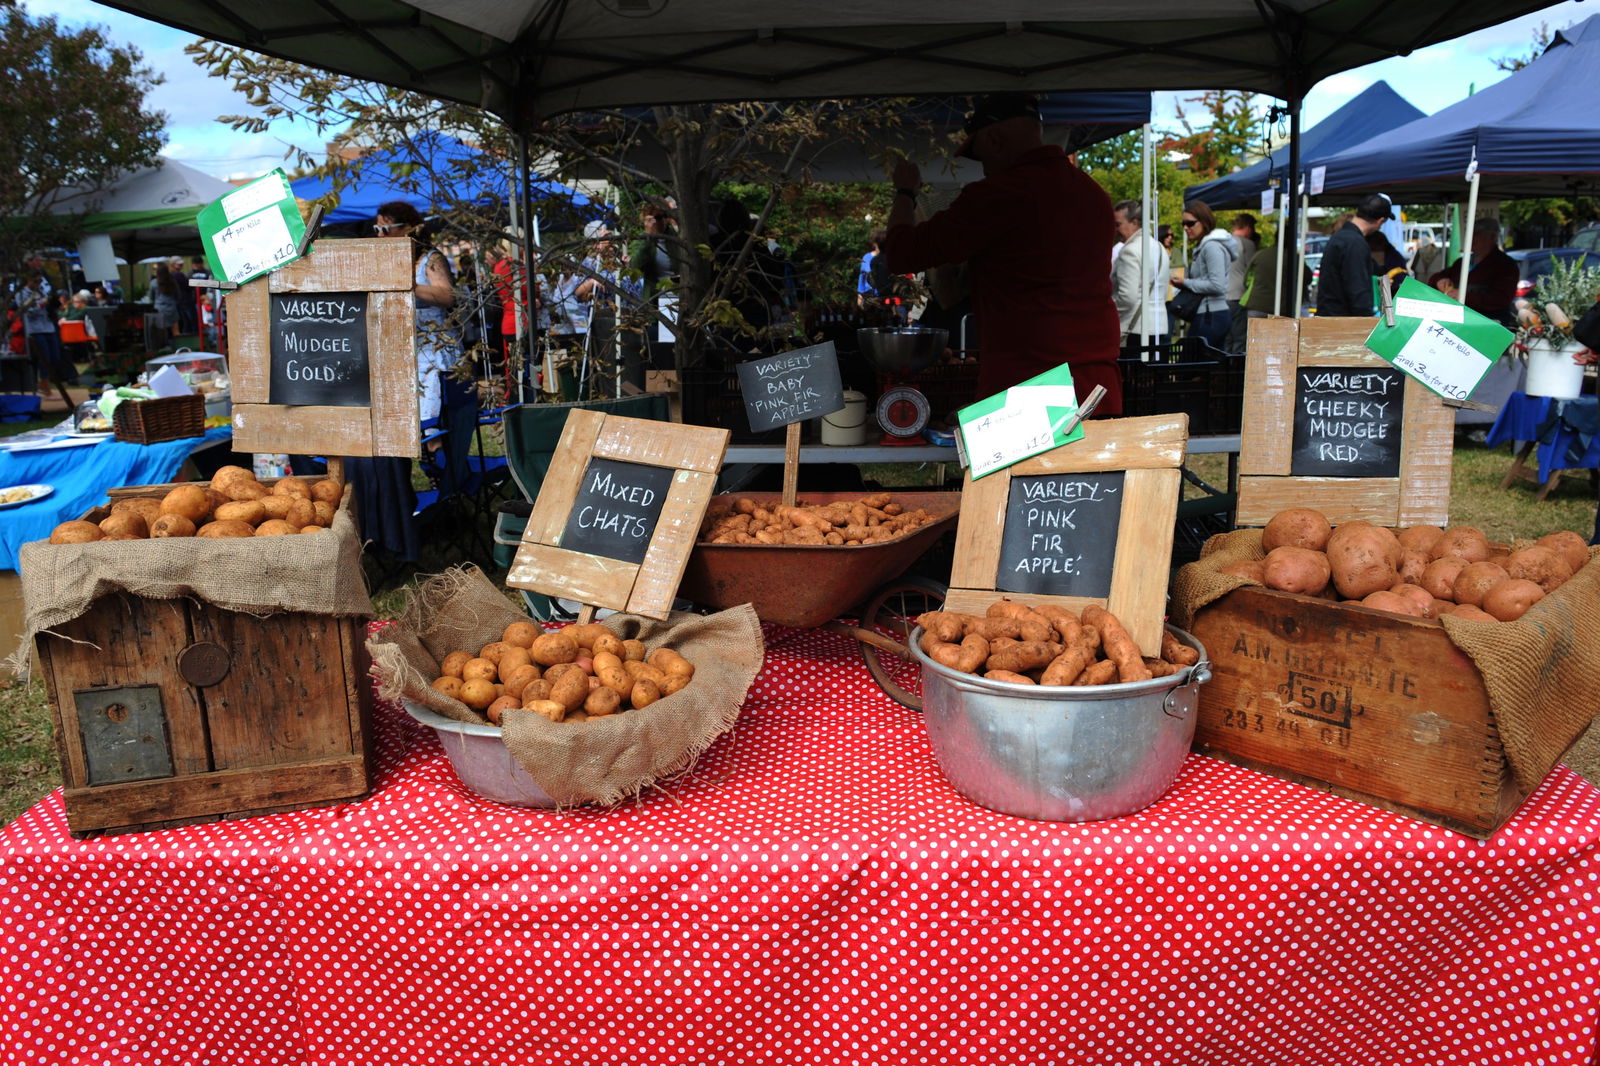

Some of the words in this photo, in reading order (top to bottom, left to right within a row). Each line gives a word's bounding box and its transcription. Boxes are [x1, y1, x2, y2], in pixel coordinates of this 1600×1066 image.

[273, 243, 294, 262] $10
[279, 299, 345, 319] VARIETY
[1426, 325, 1444, 338] $4
[1443, 336, 1456, 347] per
[1456, 343, 1471, 357] kilo
[756, 353, 810, 377] VARIETY
[767, 374, 805, 394] BABY
[1303, 372, 1393, 395] VARIETY
[1430, 375, 1443, 386] for
[1442, 384, 1468, 400] $10
[794, 387, 822, 404] FIR
[1310, 418, 1389, 440] MUDGEE
[589, 471, 655, 507] MIXED
[1022, 481, 1100, 500] VARIETY
[1031, 534, 1064, 554] FIR
